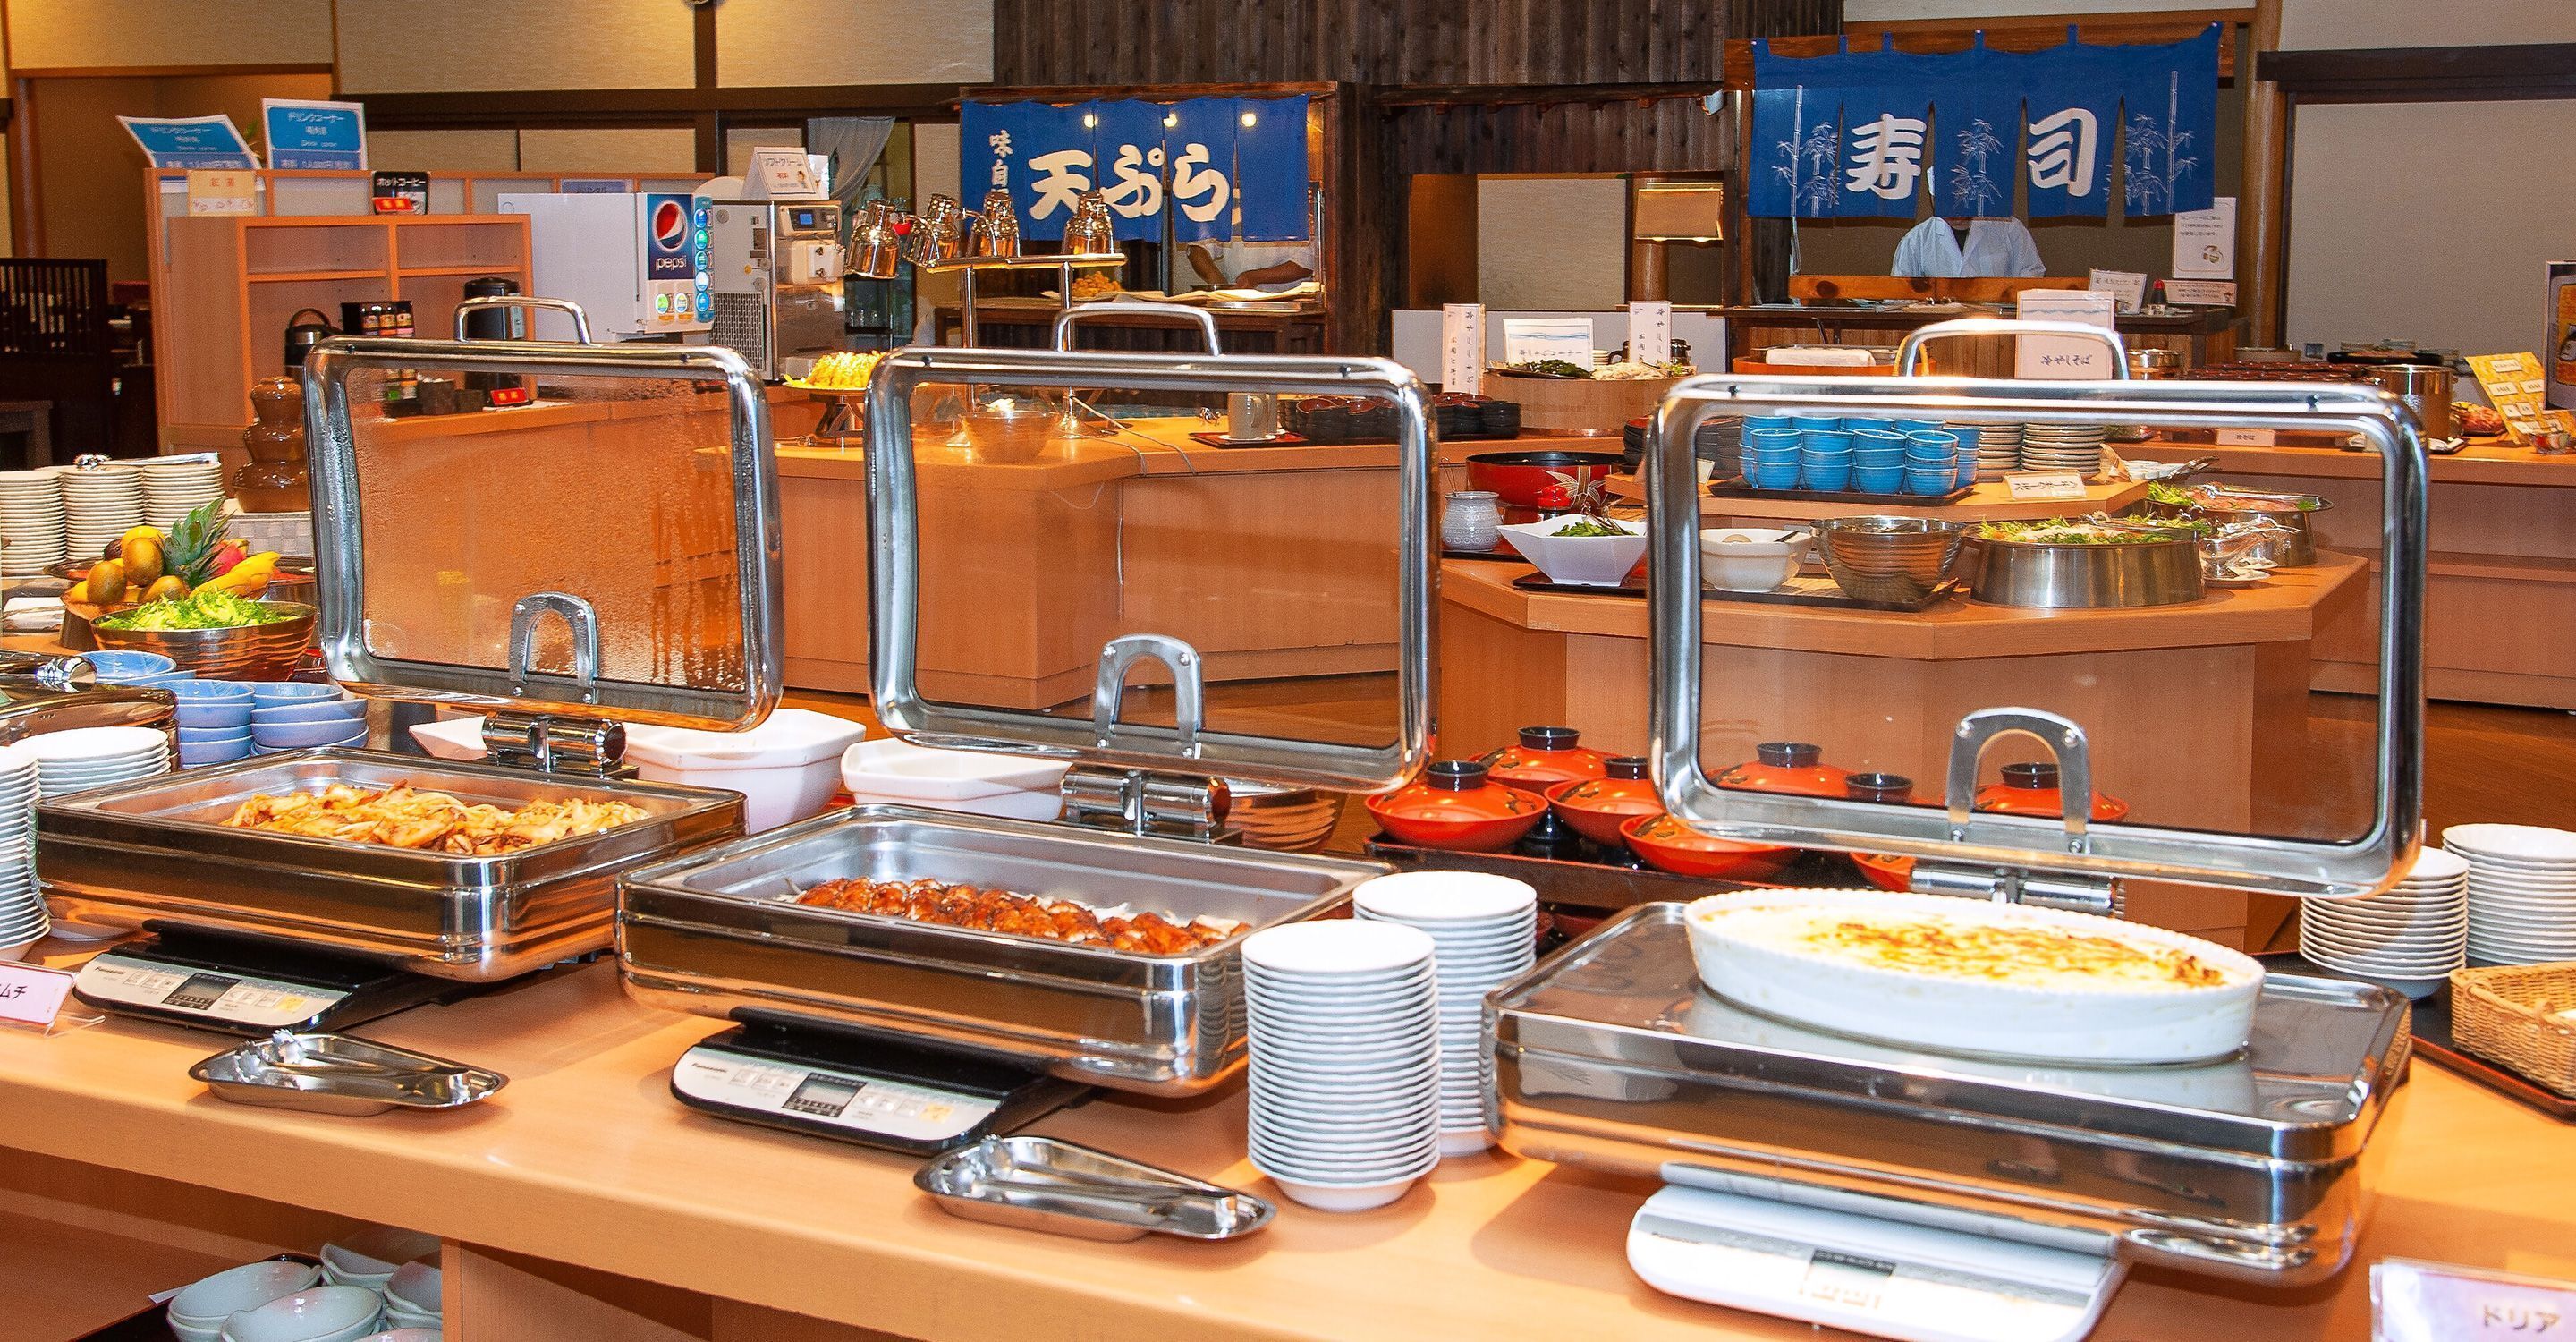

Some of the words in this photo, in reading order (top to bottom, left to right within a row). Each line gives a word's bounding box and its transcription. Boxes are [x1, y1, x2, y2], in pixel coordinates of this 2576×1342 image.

[988, 129, 1013, 194] 味自
[1845, 108, 2098, 200] 寿司
[377, 177, 427, 188] ホットコーヒー
[1028, 143, 1230, 223] 天ぷら
[655, 255, 687, 271] pepsi
[2040, 354, 2093, 367] 冷やしそば
[2483, 1304, 2562, 1334] ドリア
